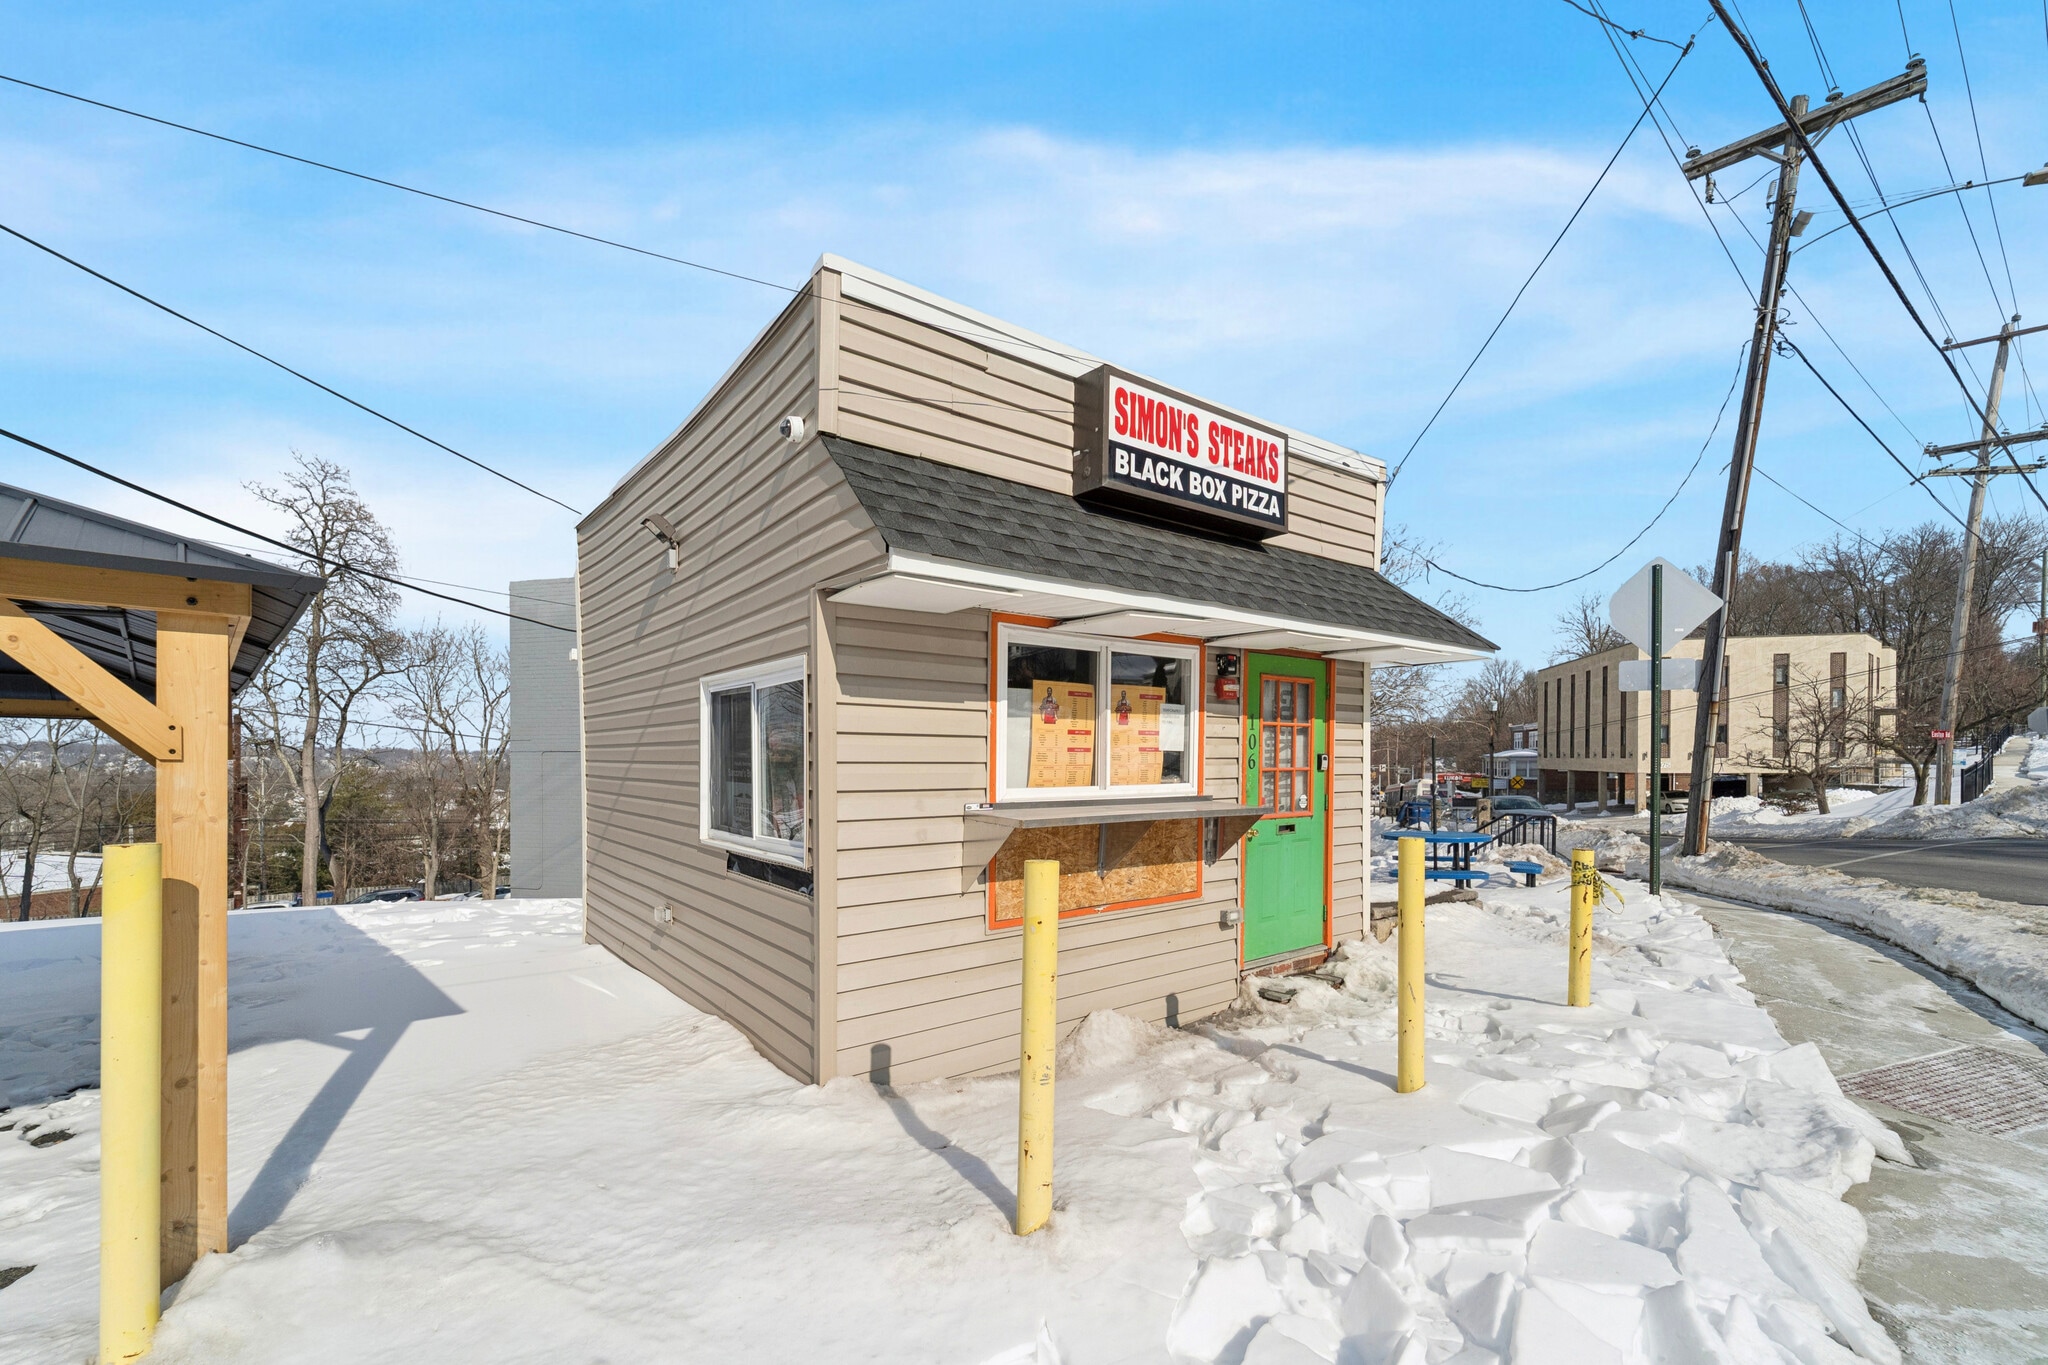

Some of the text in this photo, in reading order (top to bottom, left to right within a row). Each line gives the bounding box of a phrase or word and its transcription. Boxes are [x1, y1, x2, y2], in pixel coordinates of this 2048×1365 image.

[1114, 386, 1279, 484] SIMON'S STEAKS
[1115, 448, 1281, 518] BLACK BOX PIZZA
